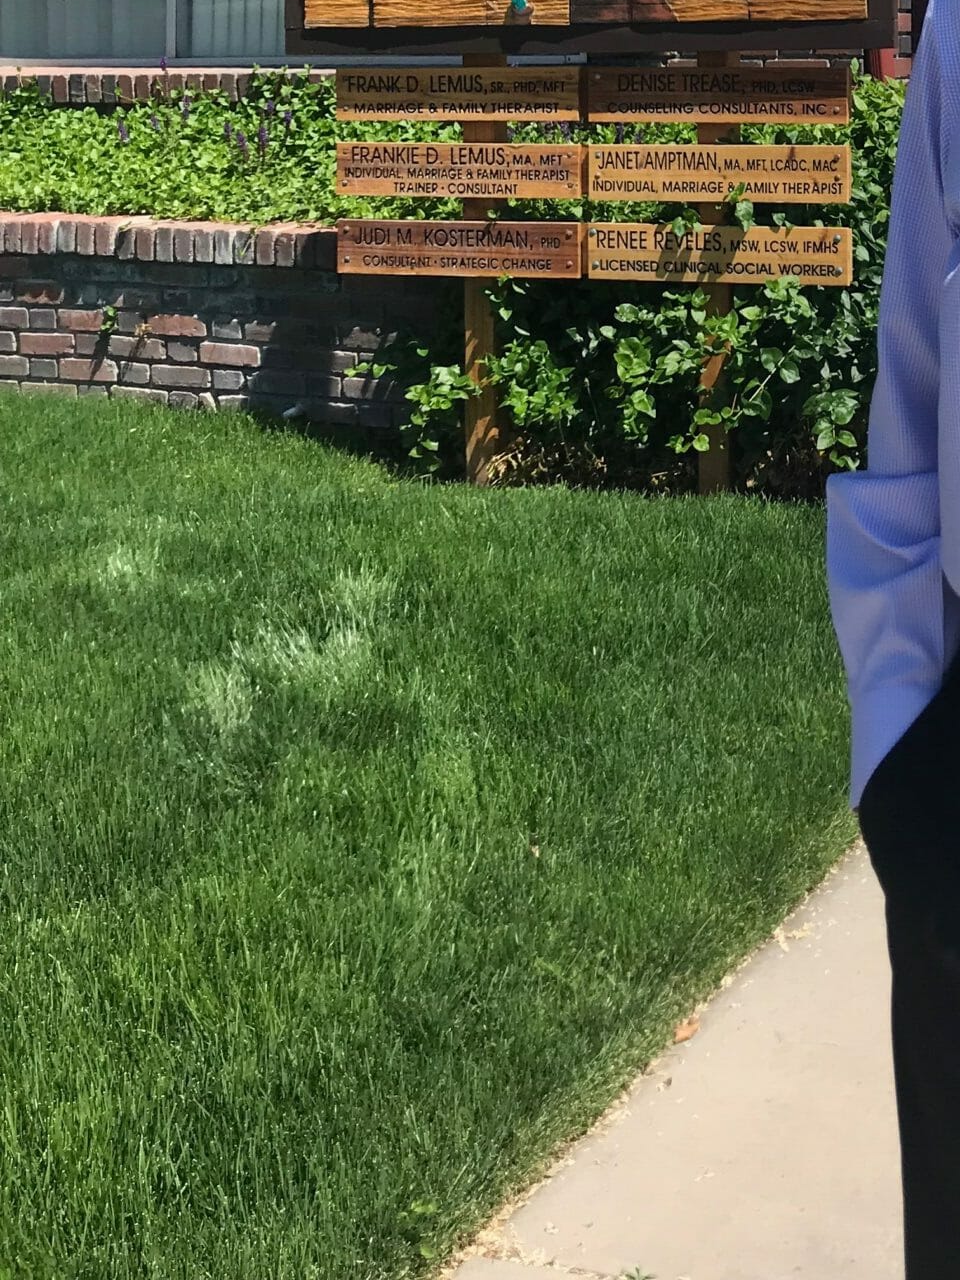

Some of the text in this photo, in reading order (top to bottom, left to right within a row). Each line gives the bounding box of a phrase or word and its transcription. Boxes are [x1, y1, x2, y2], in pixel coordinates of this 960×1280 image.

[348, 75, 401, 93] FRANK
[406, 75, 423, 93] D.
[429, 75, 488, 95] LEMUS,
[513, 81, 540, 95] PHD,
[543, 80, 565, 93] MFT
[617, 74, 675, 93] DENISE
[682, 74, 746, 95] TREASE,
[752, 82, 779, 95] PHD,
[354, 103, 559, 114] MARRIAGE & FAMILY THERAPIST
[607, 102, 827, 116] COUNSELING CONSULTANTS, INC
[351, 146, 419, 165] FRANKIE
[426, 148, 443, 165] D.
[450, 148, 510, 168] LEMUS,
[540, 155, 562, 166] MFT
[598, 152, 640, 170] JANET
[645, 152, 721, 173] AMPTMAN,
[724, 160, 744, 172] MA,
[770, 160, 810, 172] LCADC,
[812, 160, 838, 172] MAC
[345, 167, 569, 181] INDIVIDUAL, MARRIAGE & FAMILY THERAPIST
[394, 183, 518, 195] TRAINER CONSULTANT
[592, 180, 659, 193] INDIVIDUAL,
[662, 181, 723, 193] MARRIAGE
[738, 182, 779, 194] AMILY
[782, 182, 843, 194] THERAPIST
[355, 228, 561, 250] JUDI M. KOSTERMAN, PHD
[596, 230, 647, 249] RENEE
[654, 231, 726, 253] REVELES,
[730, 240, 760, 253] MSW,
[765, 241, 799, 254] LCSW,
[363, 255, 551, 270] CONSULTANT STRATEGIC CHANGE
[600, 260, 836, 276] LICENSED CLINICAL SOCIAL WORKER
